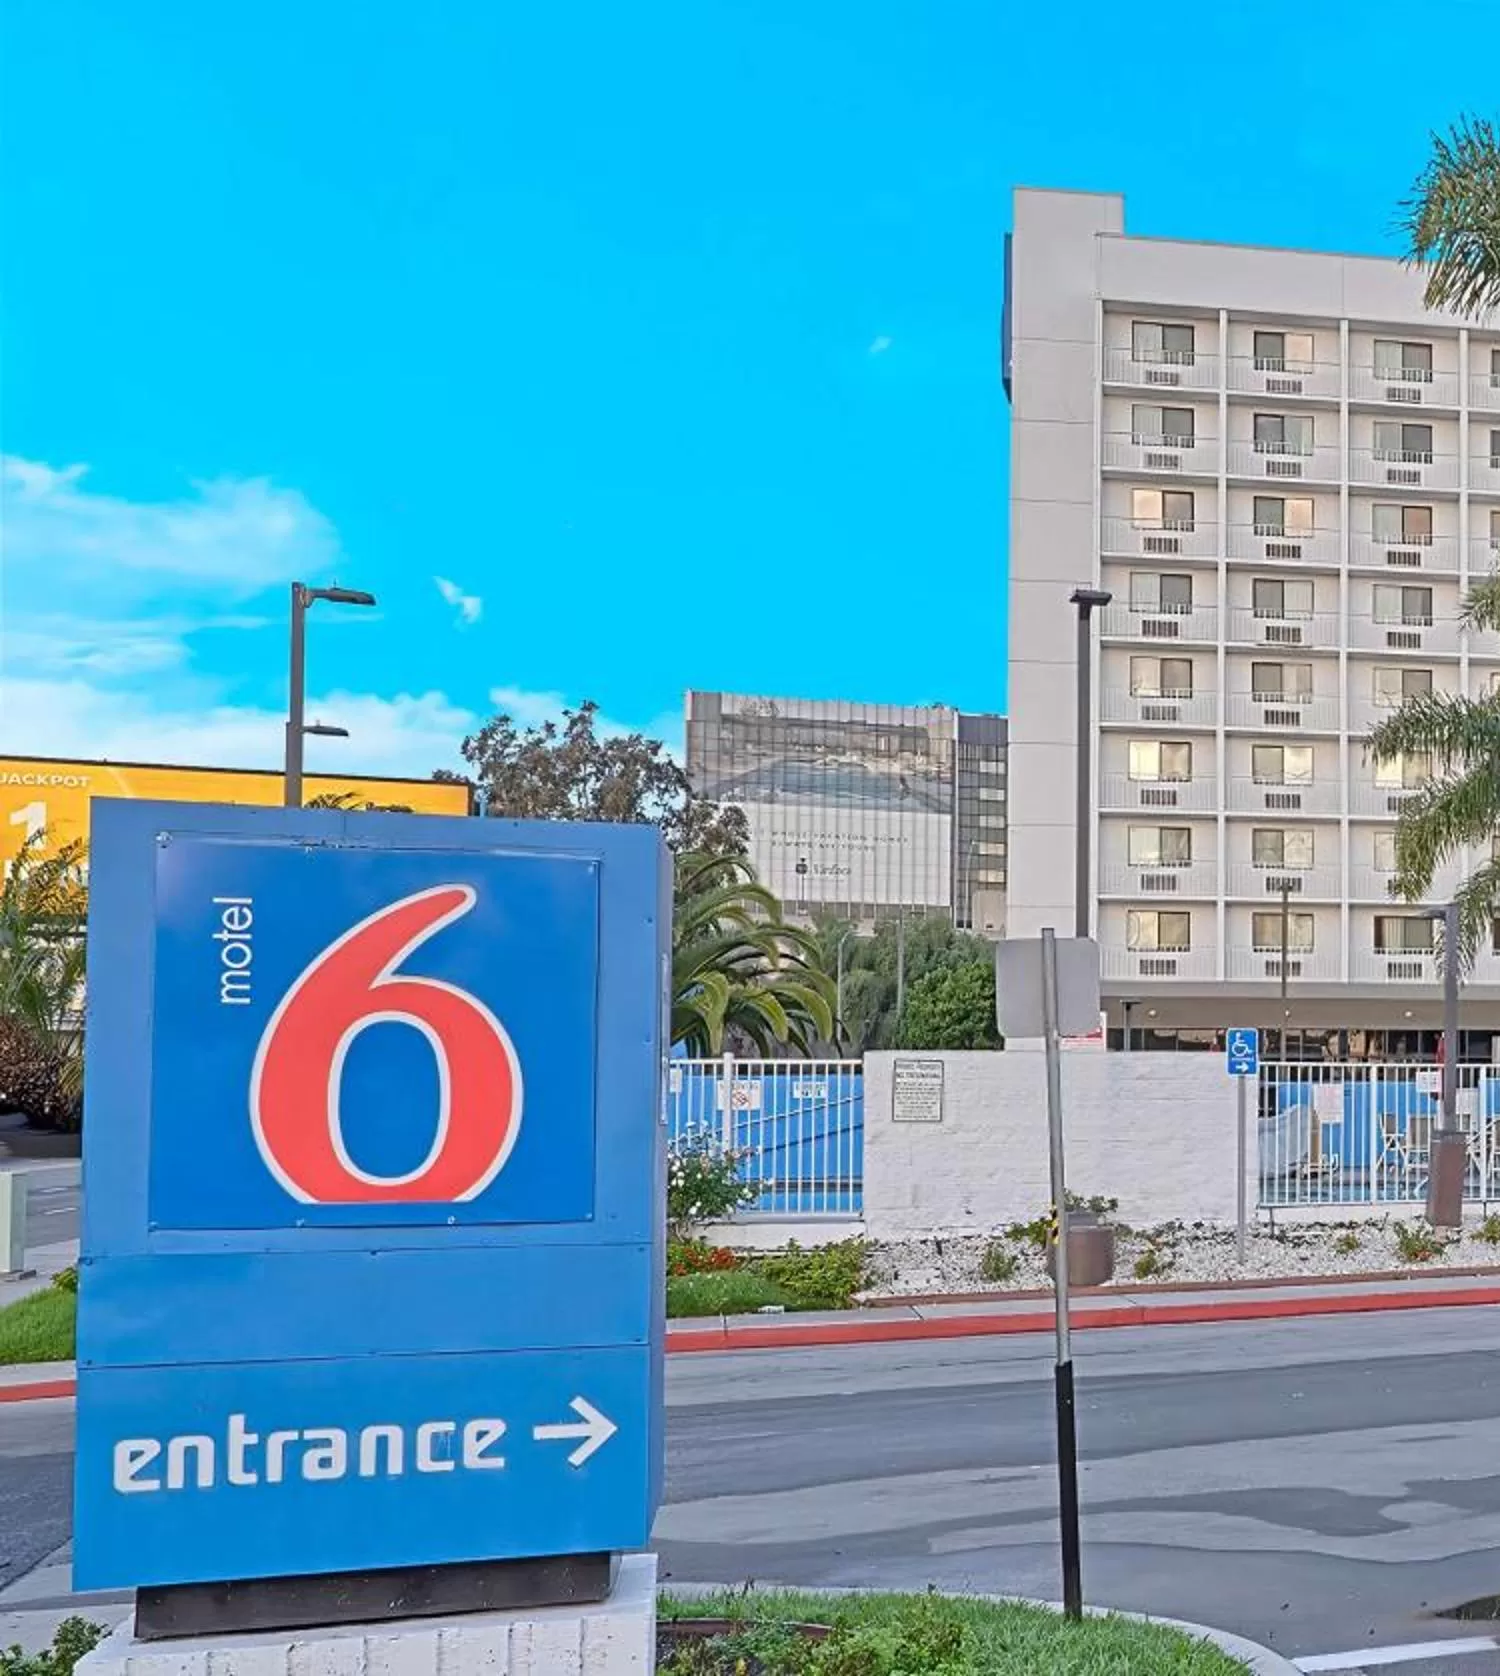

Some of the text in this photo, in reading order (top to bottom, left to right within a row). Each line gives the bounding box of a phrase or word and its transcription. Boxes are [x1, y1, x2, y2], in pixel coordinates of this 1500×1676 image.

[0, 772, 91, 788] JACKPOT
[9, 801, 47, 849] 1
[213, 897, 253, 1006] motel
[249, 883, 525, 1205] 6
[113, 1413, 506, 1494] entrance
